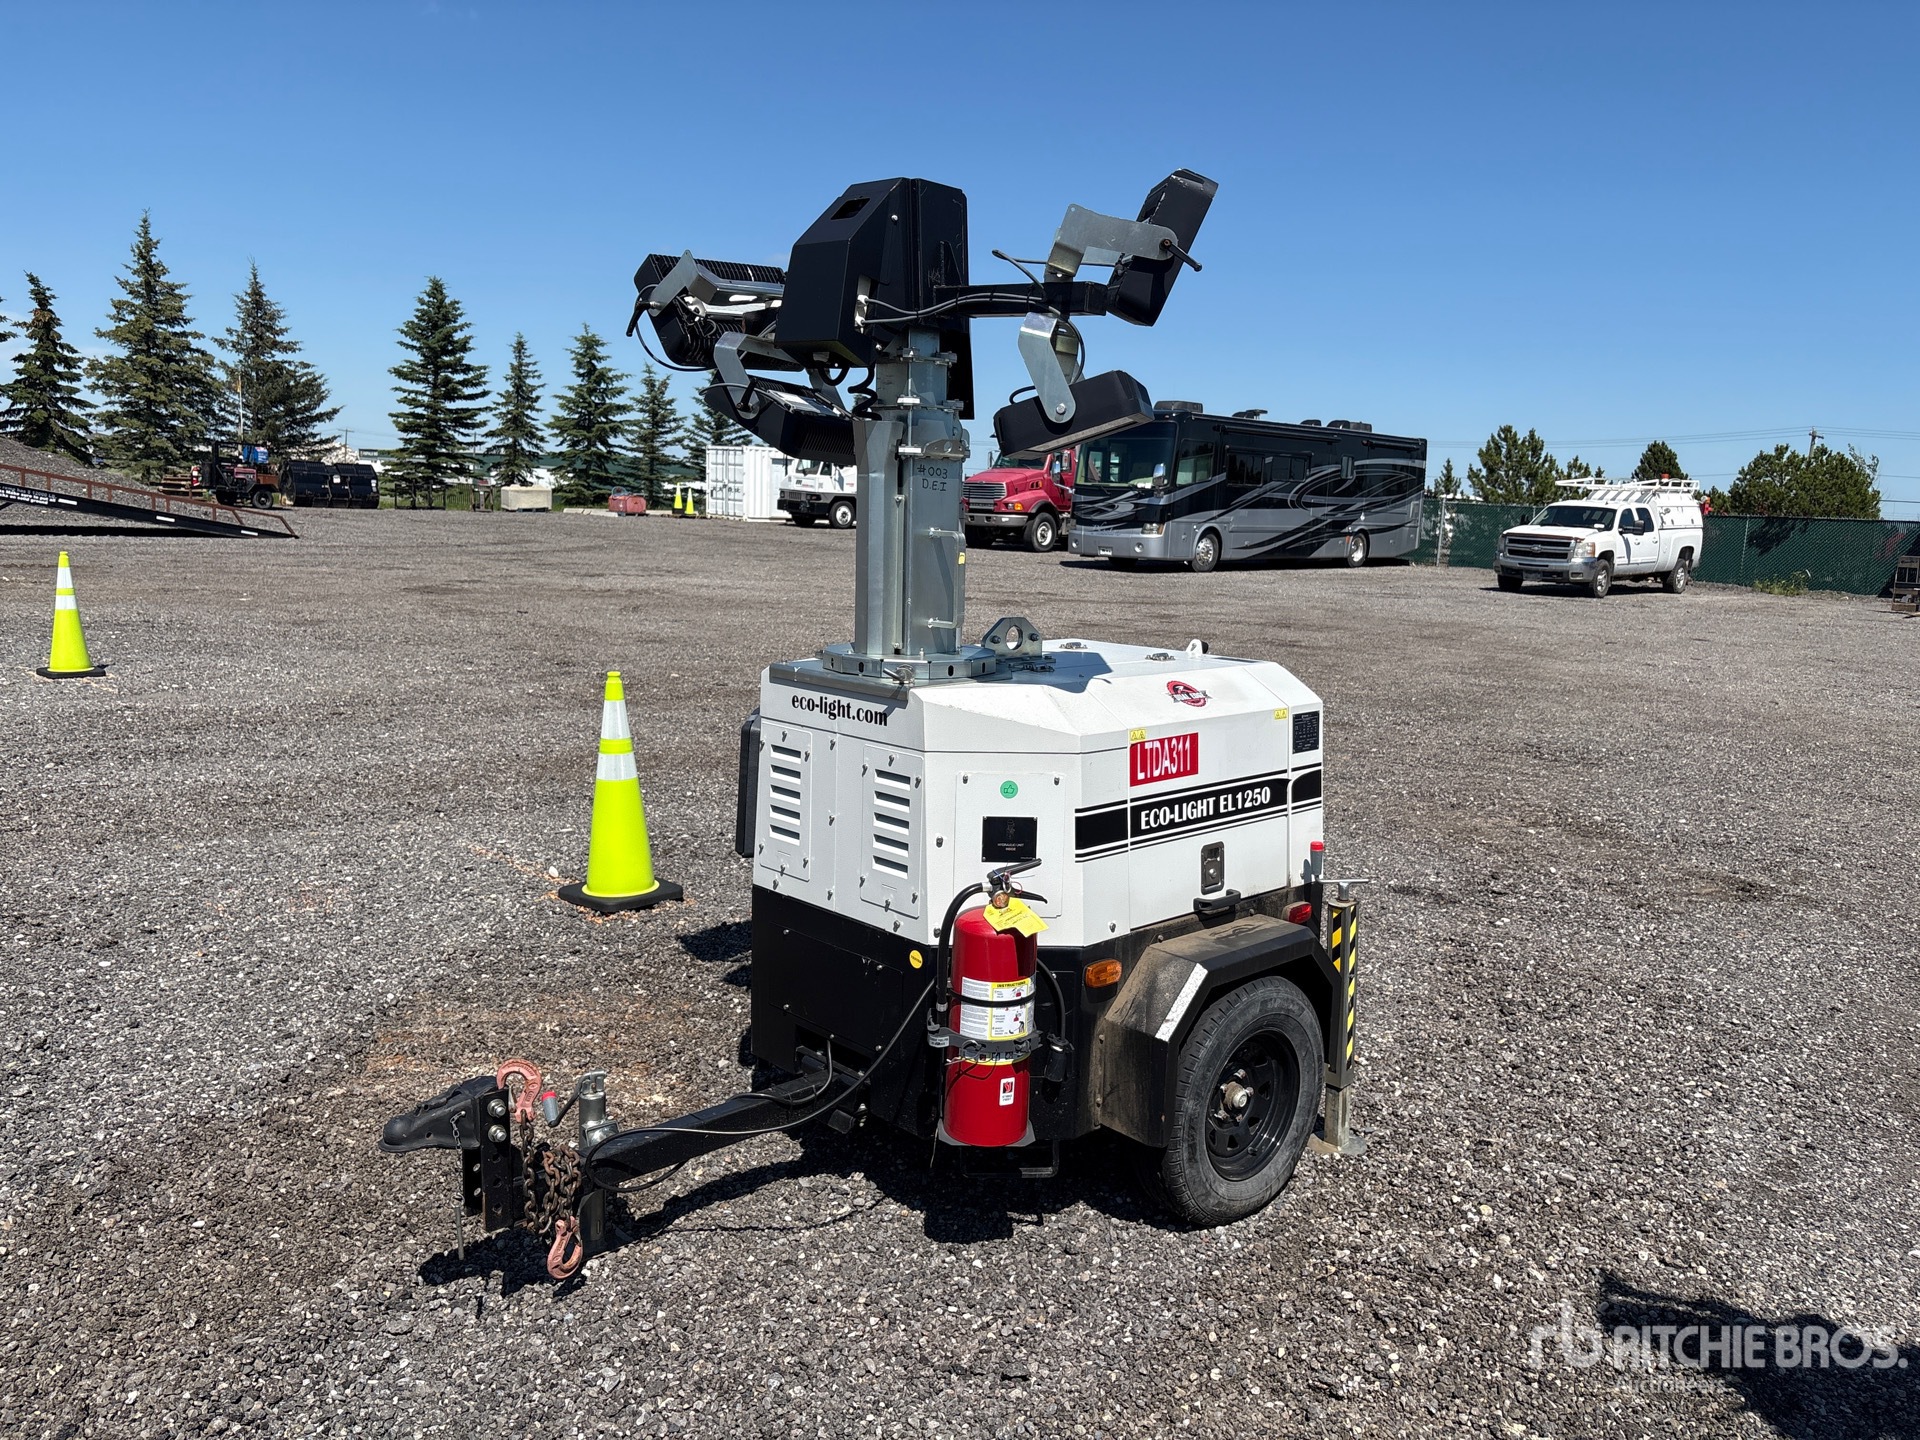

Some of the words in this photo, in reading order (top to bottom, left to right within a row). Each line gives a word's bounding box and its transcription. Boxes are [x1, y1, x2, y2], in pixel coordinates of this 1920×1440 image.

[917, 464, 948, 480] #003
[791, 694, 888, 727] eco-light.com
[1137, 735, 1191, 781] LTDA311
[1140, 797, 1216, 830] ECO-LIGHT
[1219, 786, 1271, 814] EL1250
